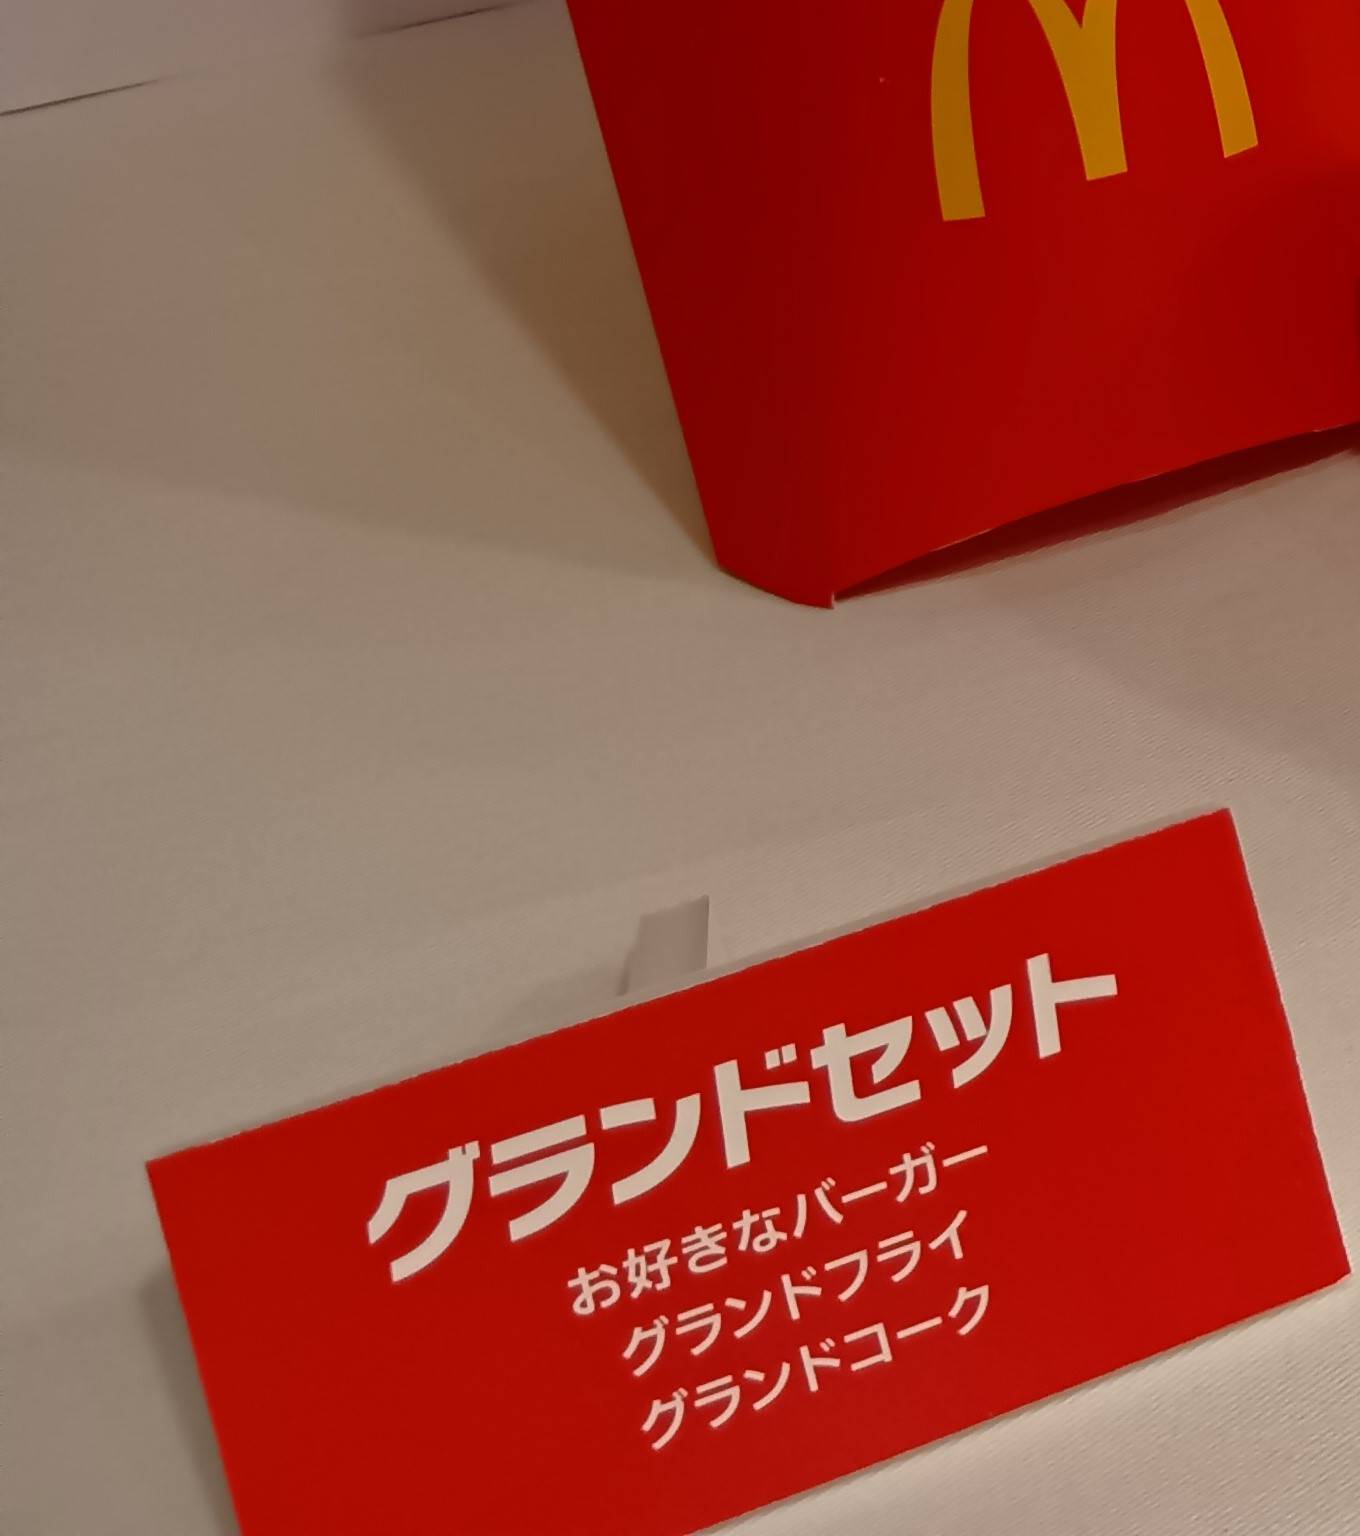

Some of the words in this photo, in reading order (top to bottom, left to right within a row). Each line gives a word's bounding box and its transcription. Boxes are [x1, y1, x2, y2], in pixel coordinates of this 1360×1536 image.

[366, 952, 1119, 1284] グランドセット
[566, 1139, 990, 1319] お好きなバーガー
[621, 1208, 970, 1377] グランドフライ
[640, 1283, 992, 1453] グランドコーク
